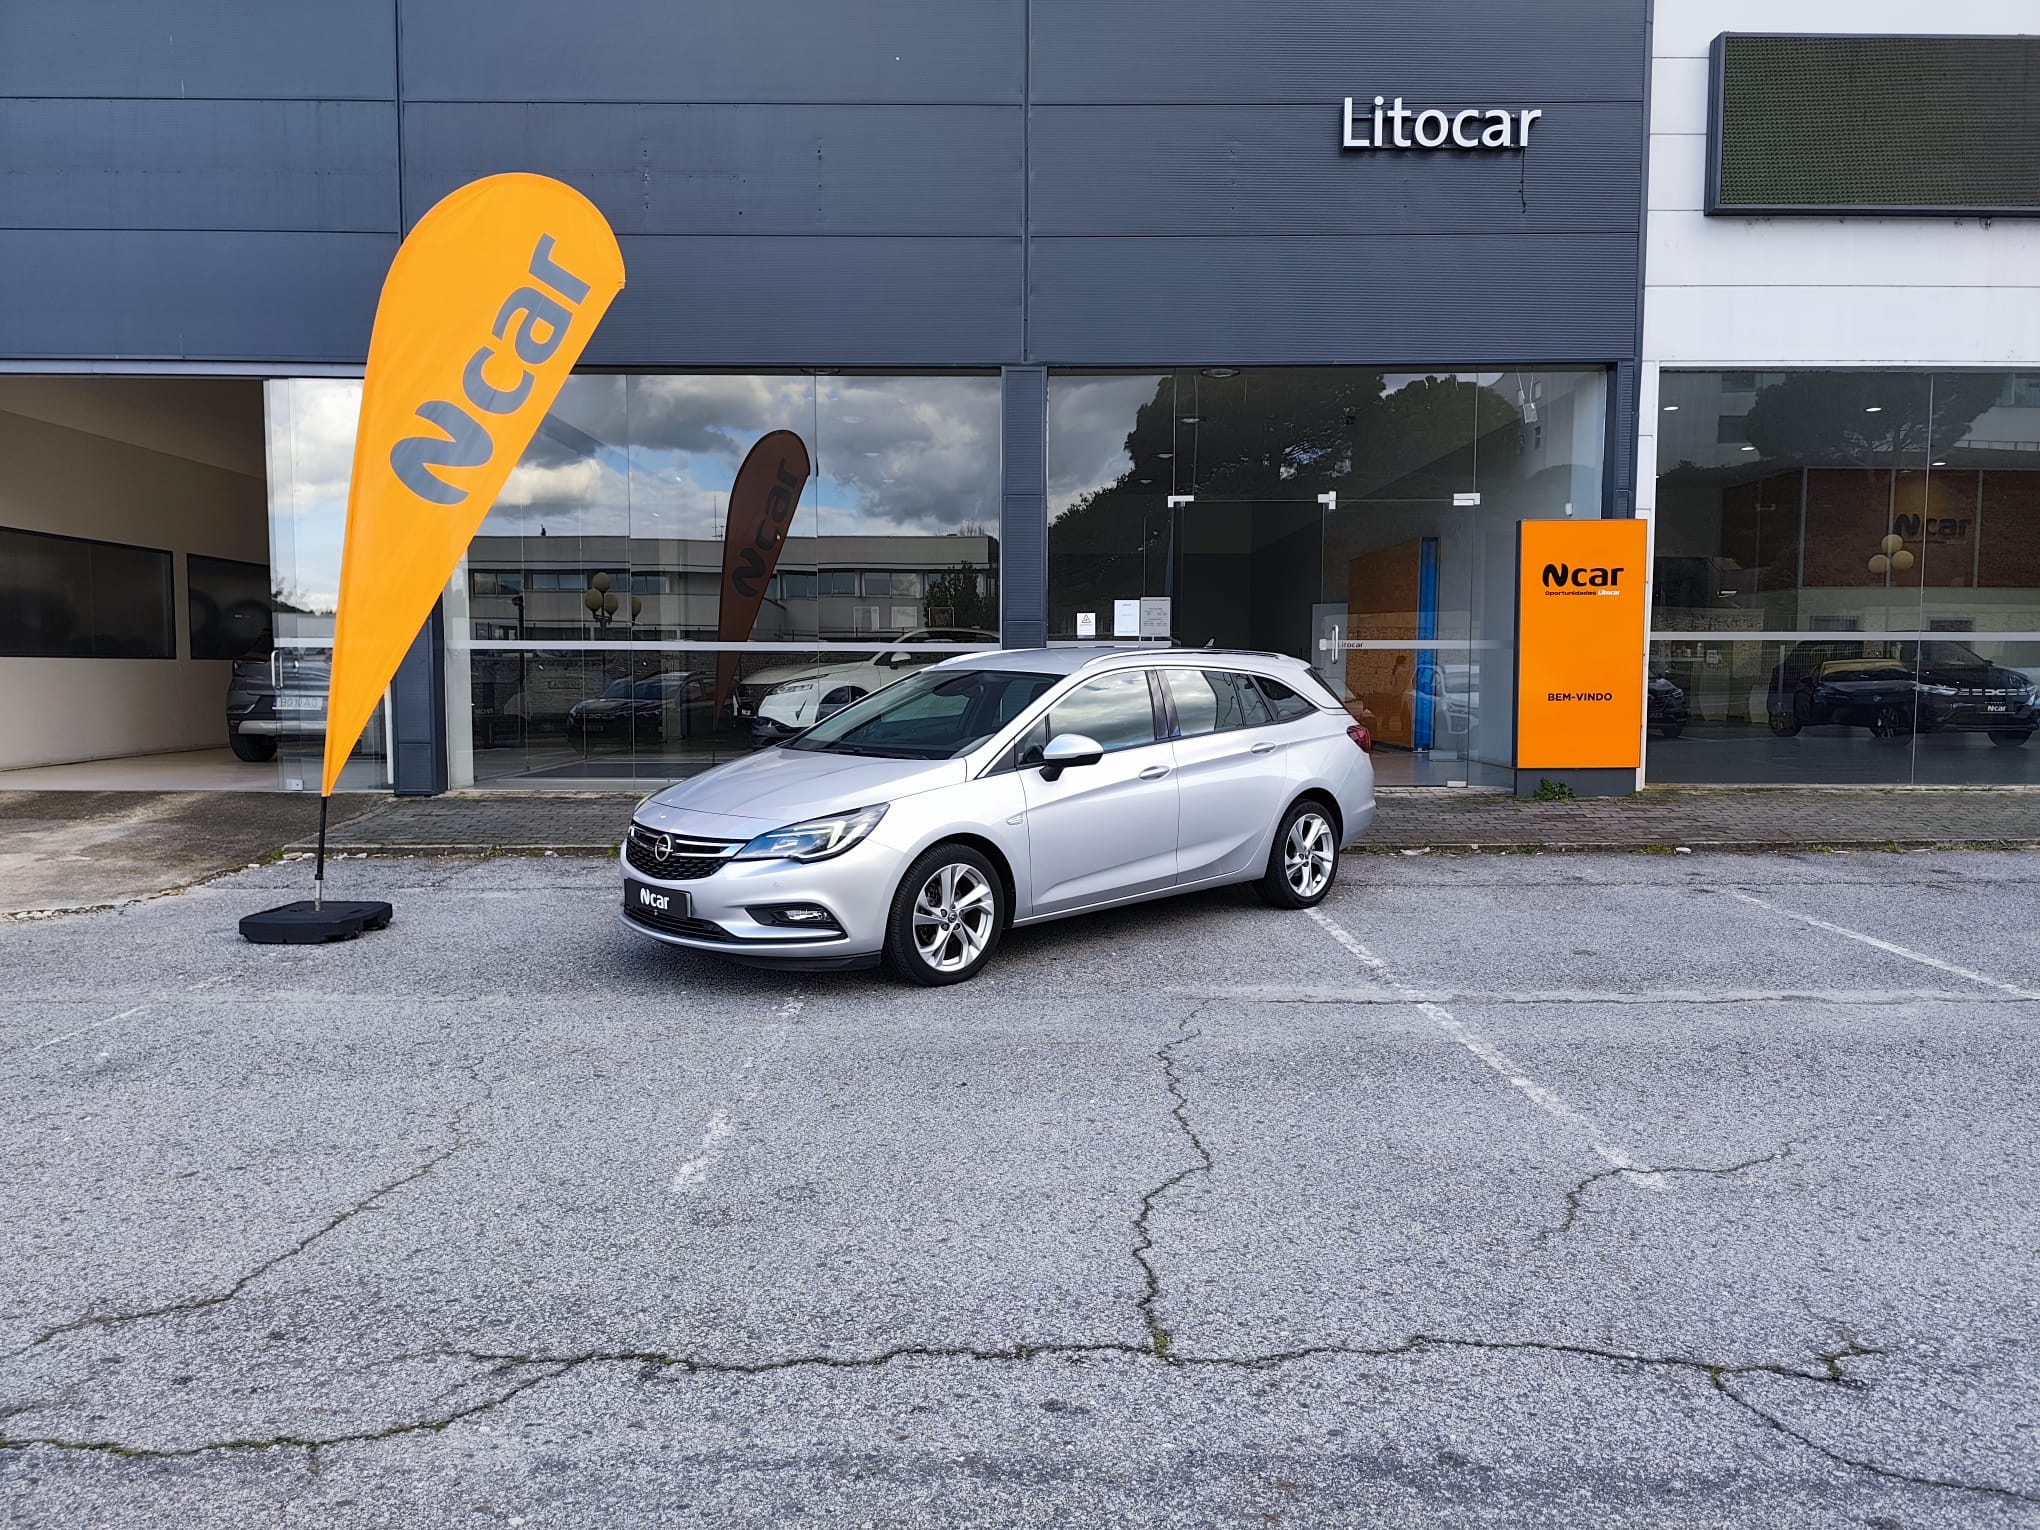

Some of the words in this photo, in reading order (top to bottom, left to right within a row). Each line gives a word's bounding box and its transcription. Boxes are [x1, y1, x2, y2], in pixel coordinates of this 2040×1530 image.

[1343, 95, 1542, 148] Litocar
[389, 232, 591, 506] Ncar
[1542, 563, 1624, 587] Ncar
[1547, 692, 1613, 702] BEM-VINDO
[640, 888, 669, 910] Ncar
